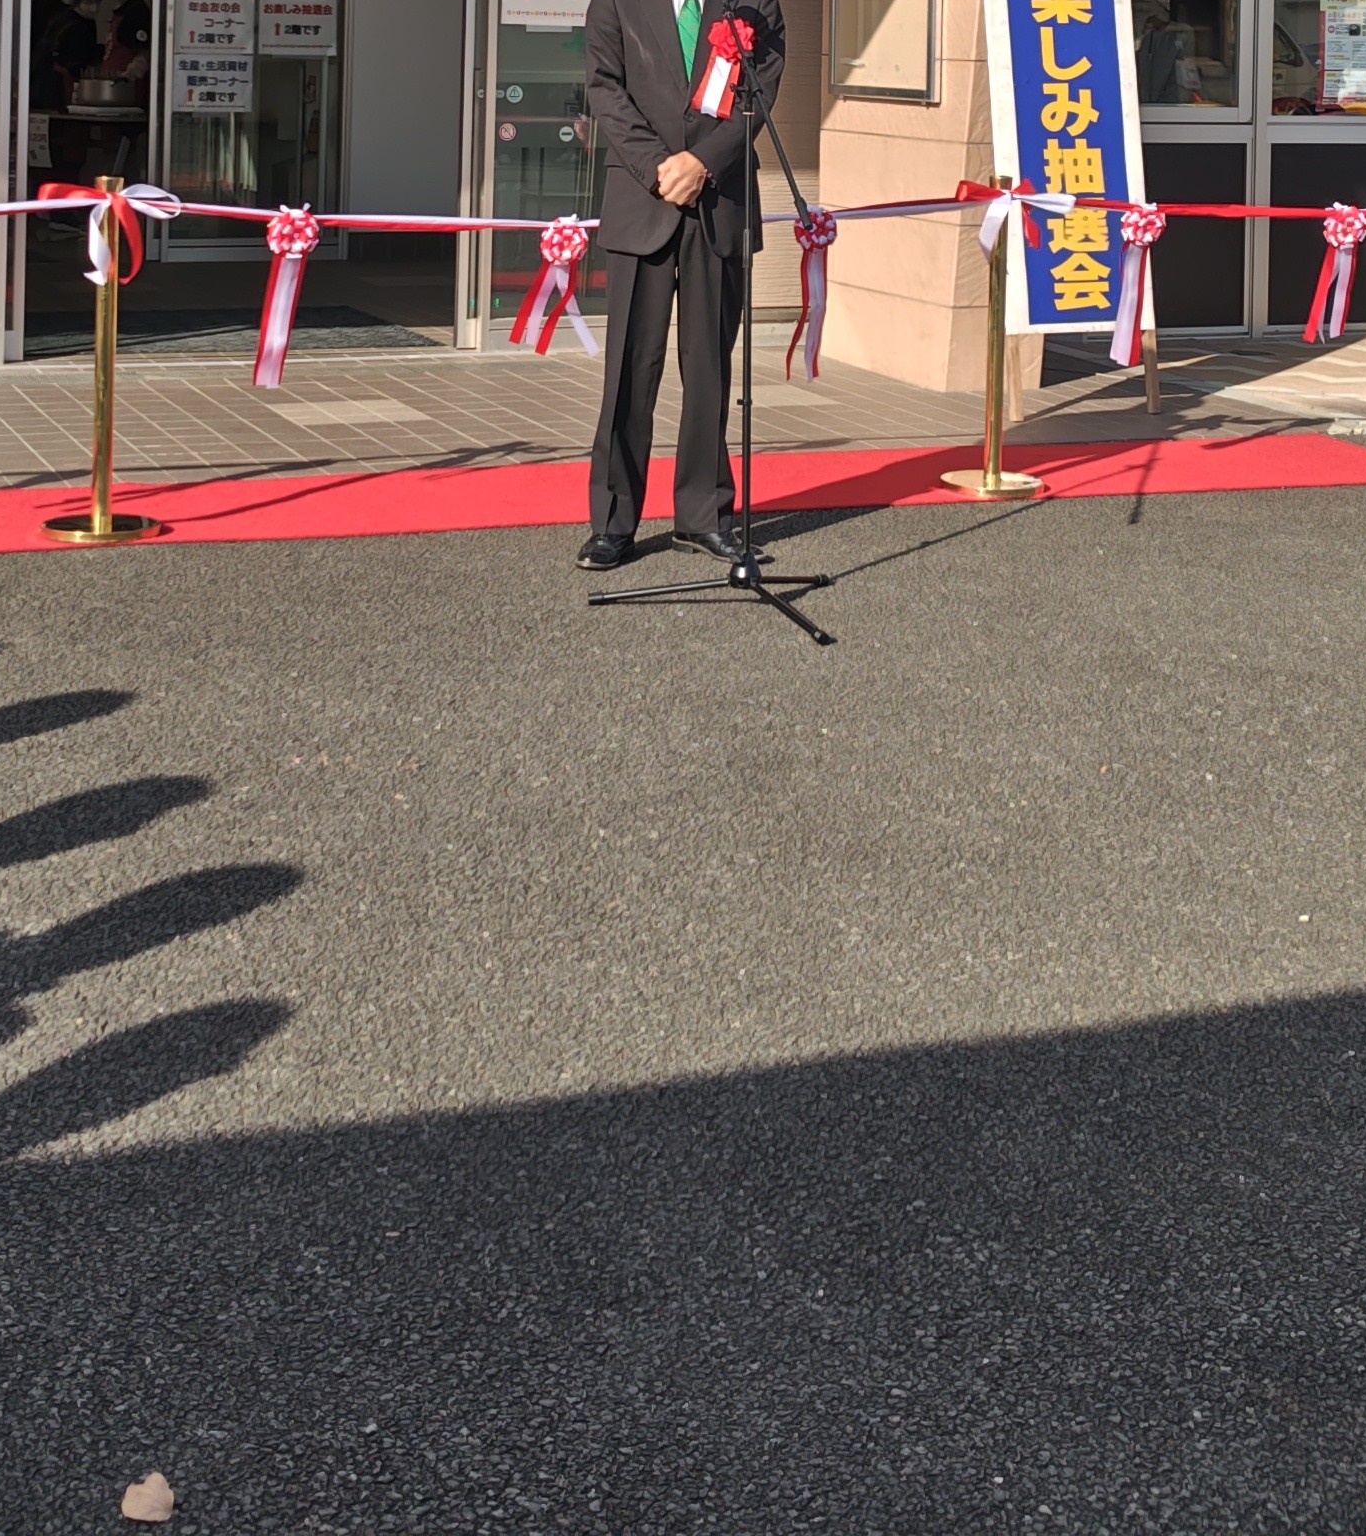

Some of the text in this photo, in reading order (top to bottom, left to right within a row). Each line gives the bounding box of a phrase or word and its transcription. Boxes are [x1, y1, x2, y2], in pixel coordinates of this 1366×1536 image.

[188, 2, 241, 14] 年金友の会
[263, 3, 334, 16] お楽しみ抽選会
[204, 17, 246, 29] コーナー
[283, 24, 322, 36] 2階です
[197, 32, 236, 45] 2階です
[186, 75, 250, 87] 販売コーナー
[198, 91, 238, 103] 2階です
